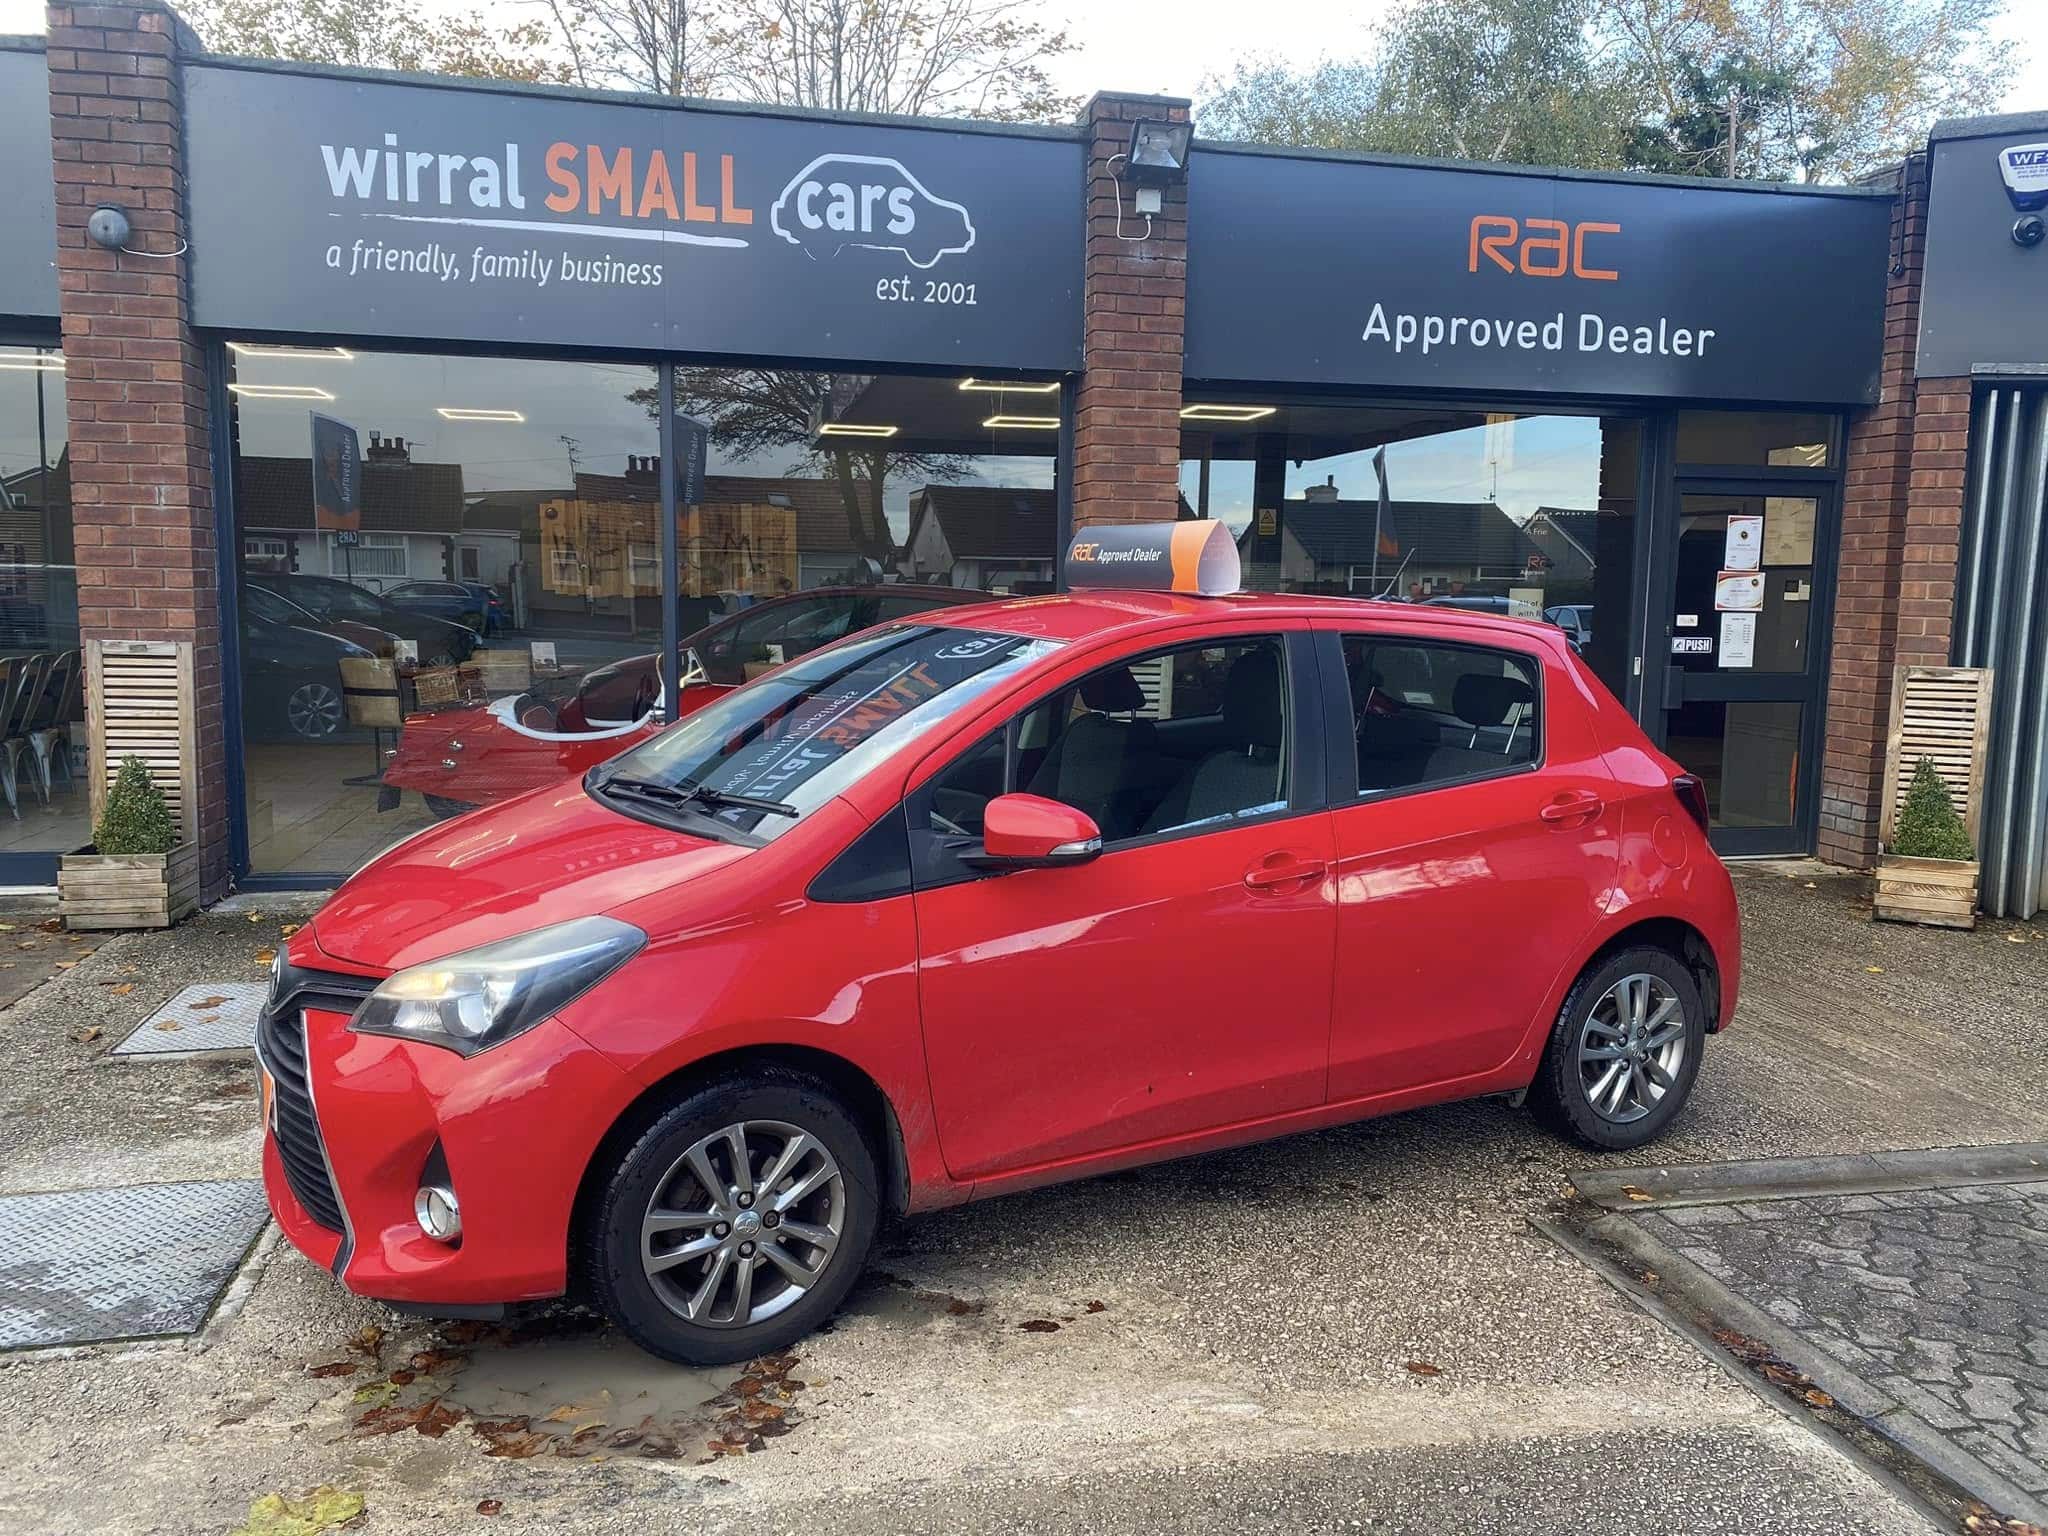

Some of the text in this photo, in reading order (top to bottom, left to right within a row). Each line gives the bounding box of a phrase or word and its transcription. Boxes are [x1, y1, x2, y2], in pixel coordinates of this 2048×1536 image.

[2014, 151, 2048, 164] WF
[320, 133, 916, 235] wirral SMALL cars
[326, 239, 663, 287] a friendly, family business
[876, 276, 978, 305] est. 2001
[1362, 301, 1716, 357] Approved Dealer
[1097, 549, 1133, 564] Approved
[1134, 548, 1162, 562] Dealer
[1686, 639, 1710, 651] PUSH
